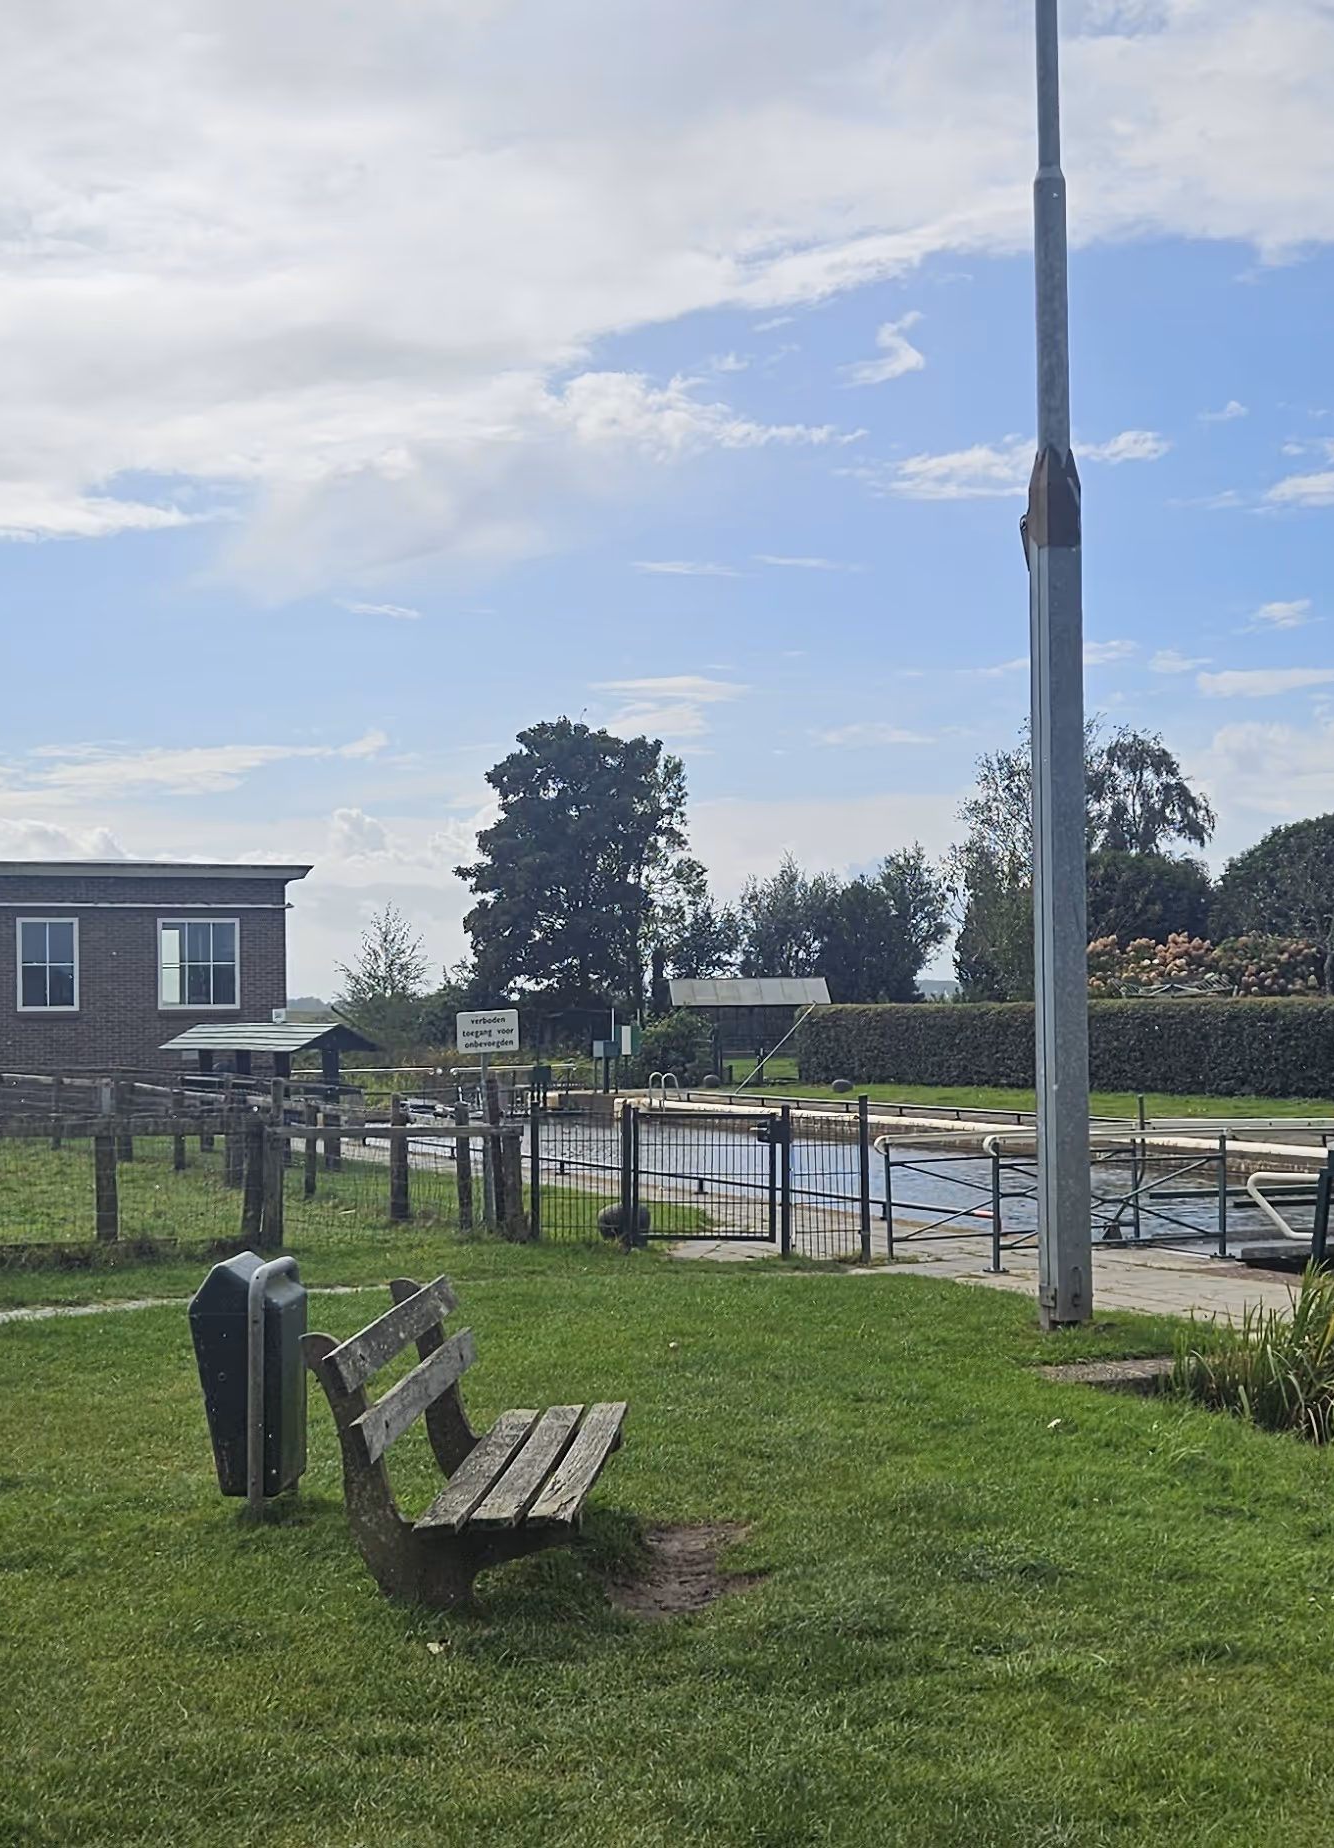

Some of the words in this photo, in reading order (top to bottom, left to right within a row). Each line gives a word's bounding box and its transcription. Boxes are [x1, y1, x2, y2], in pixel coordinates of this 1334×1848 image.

[470, 1016, 506, 1024] verboden
[462, 1030, 492, 1038] toegang
[464, 1039, 514, 1048] onbevoegden
